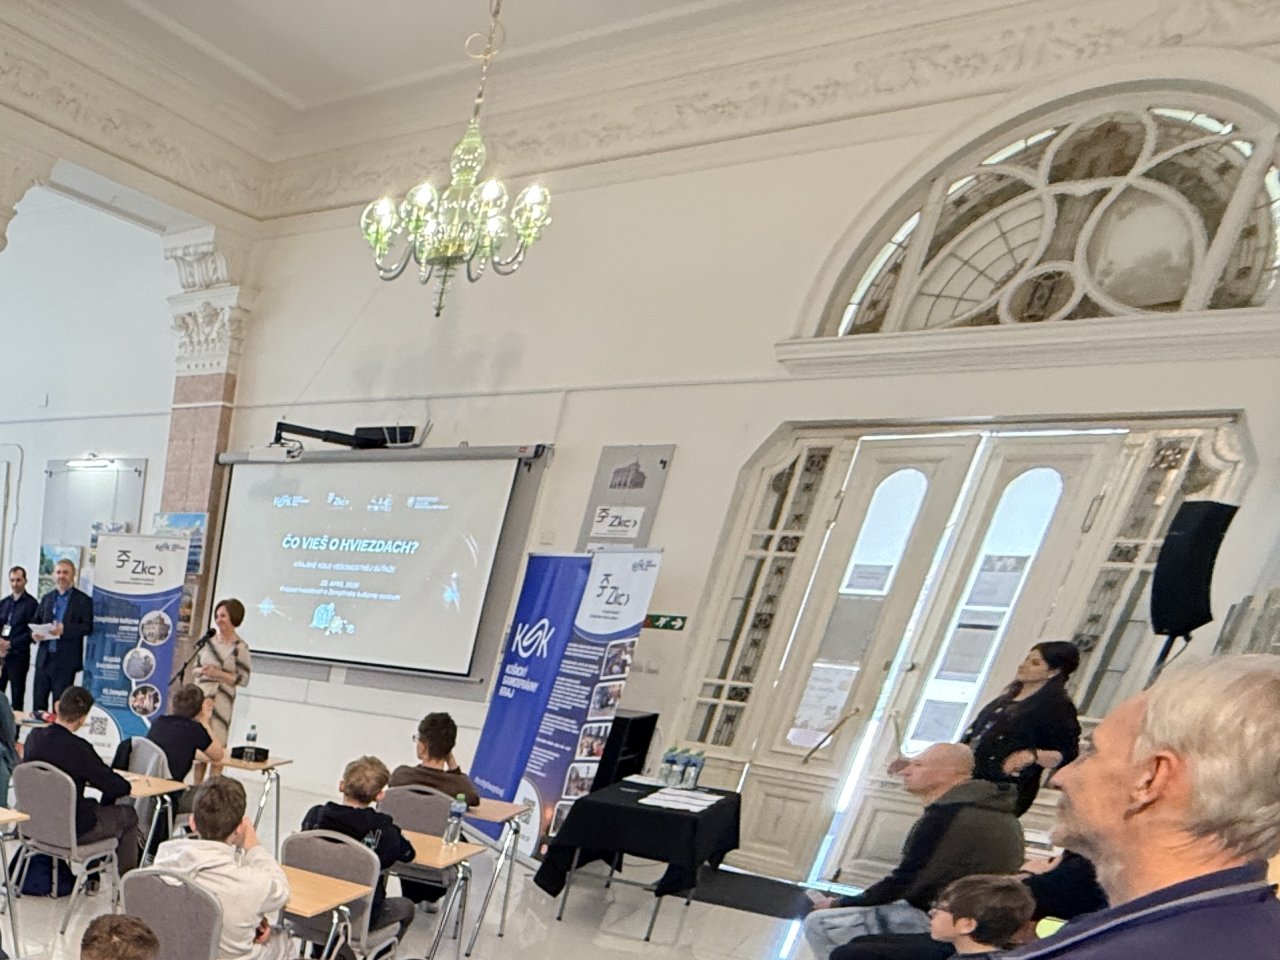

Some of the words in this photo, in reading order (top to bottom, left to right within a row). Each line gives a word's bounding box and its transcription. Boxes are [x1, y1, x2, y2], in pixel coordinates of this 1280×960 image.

[282, 534, 300, 549] ČO
[302, 535, 328, 551] VIEŠ
[329, 538, 340, 551] O
[340, 538, 419, 554] HVIEZDACH?
